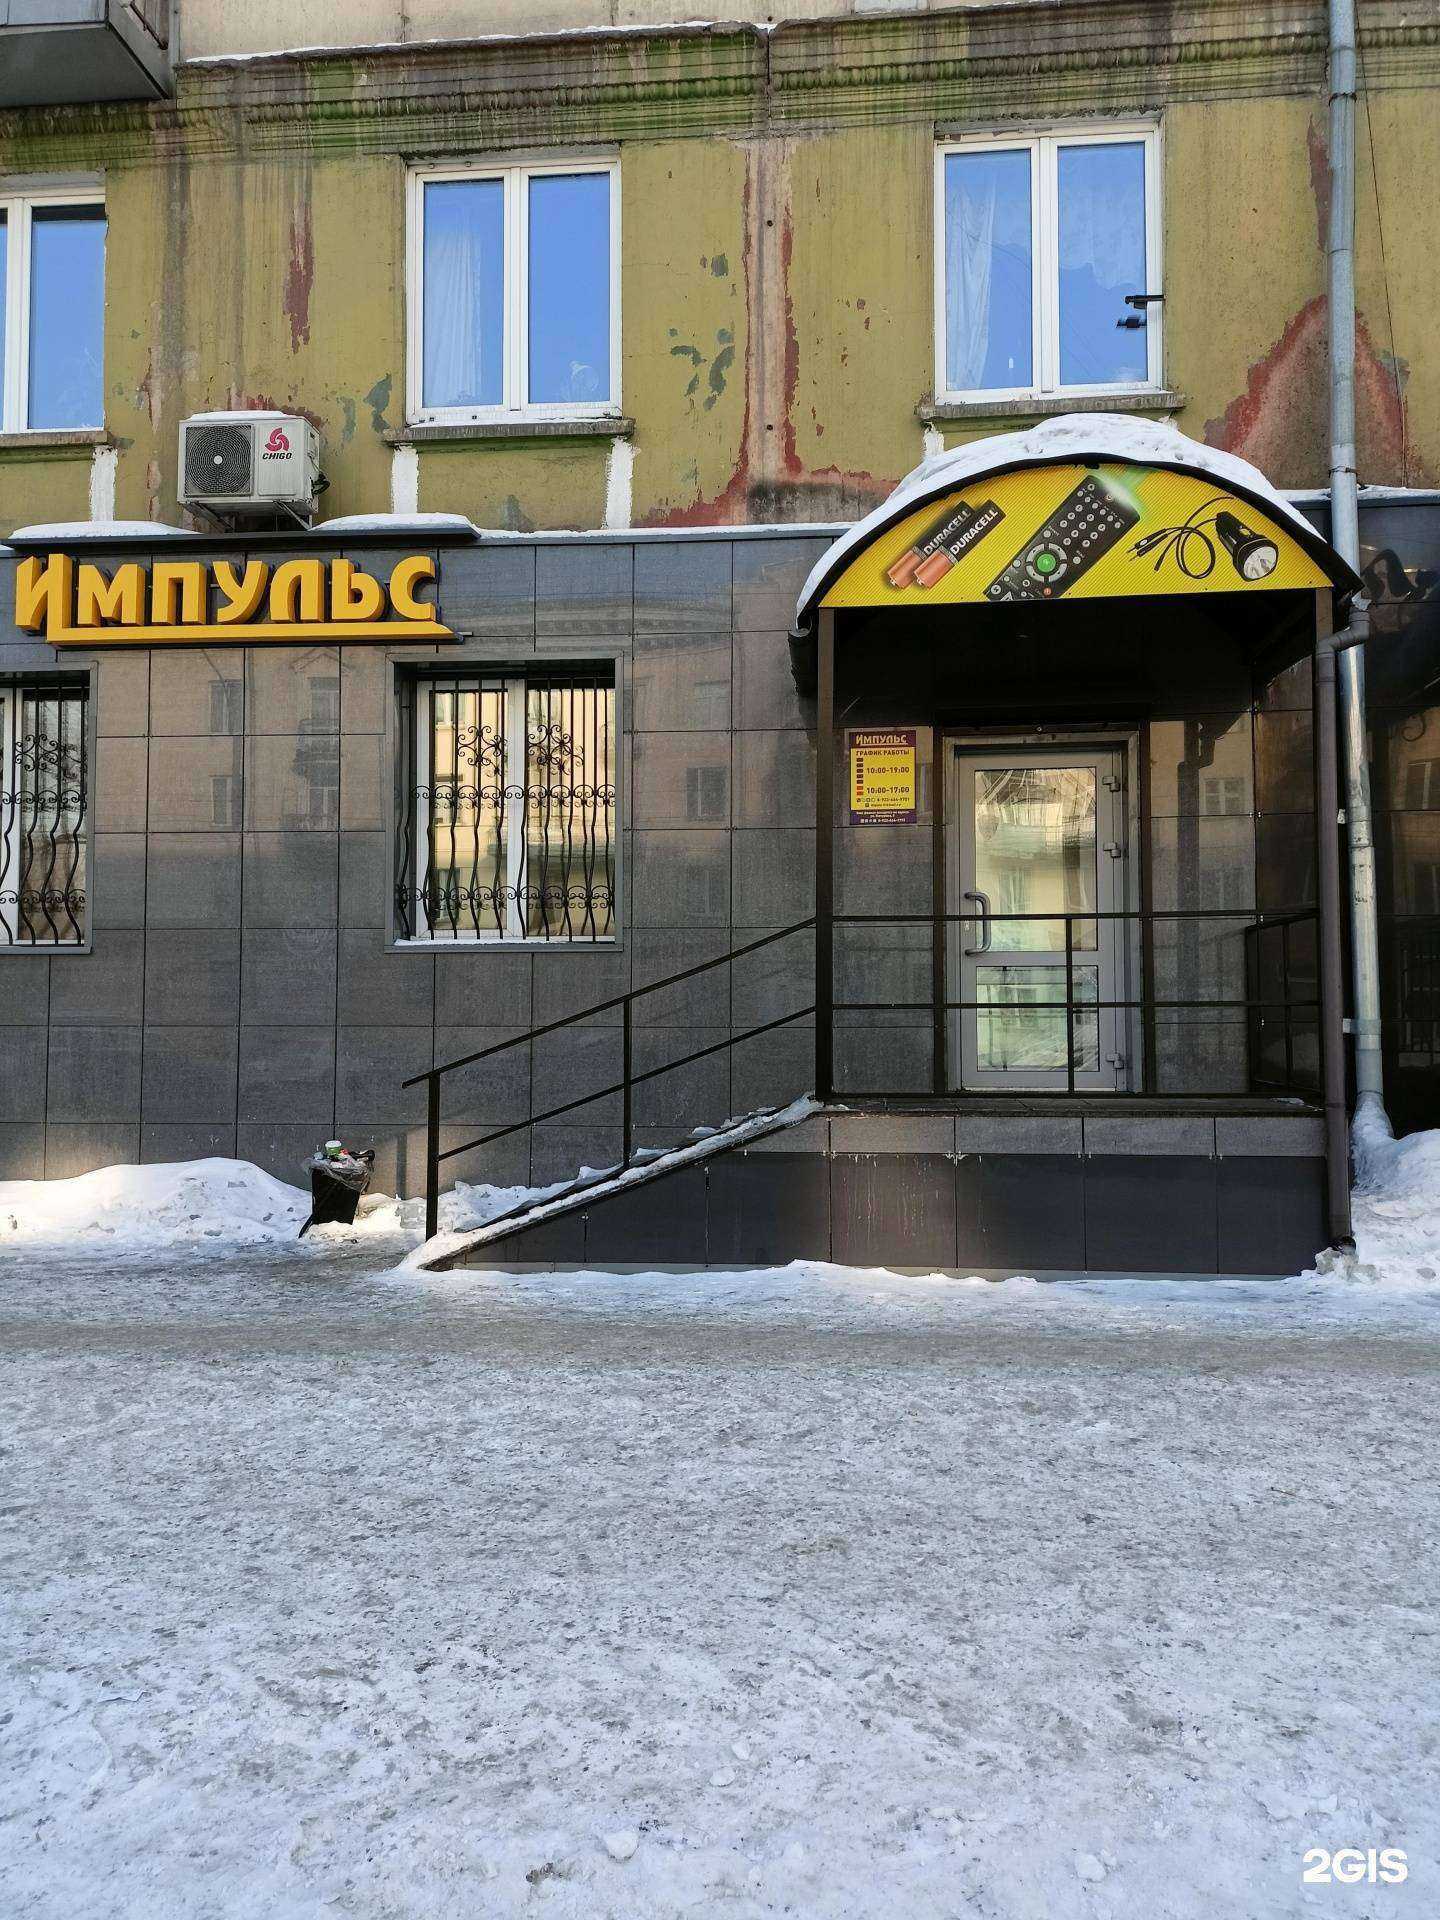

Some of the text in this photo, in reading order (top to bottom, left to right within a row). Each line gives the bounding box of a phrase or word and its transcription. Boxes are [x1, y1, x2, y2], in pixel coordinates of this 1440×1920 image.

[262, 452, 293, 460] CHIGO
[923, 508, 972, 556] DURACELL
[949, 508, 999, 556] DURACELL
[15, 553, 440, 642] ИМПУЛЬС
[856, 734, 908, 745] ИМПУЛЬС
[866, 766, 910, 774] 10:00-19:00
[866, 786, 910, 794] 10:00-17:00
